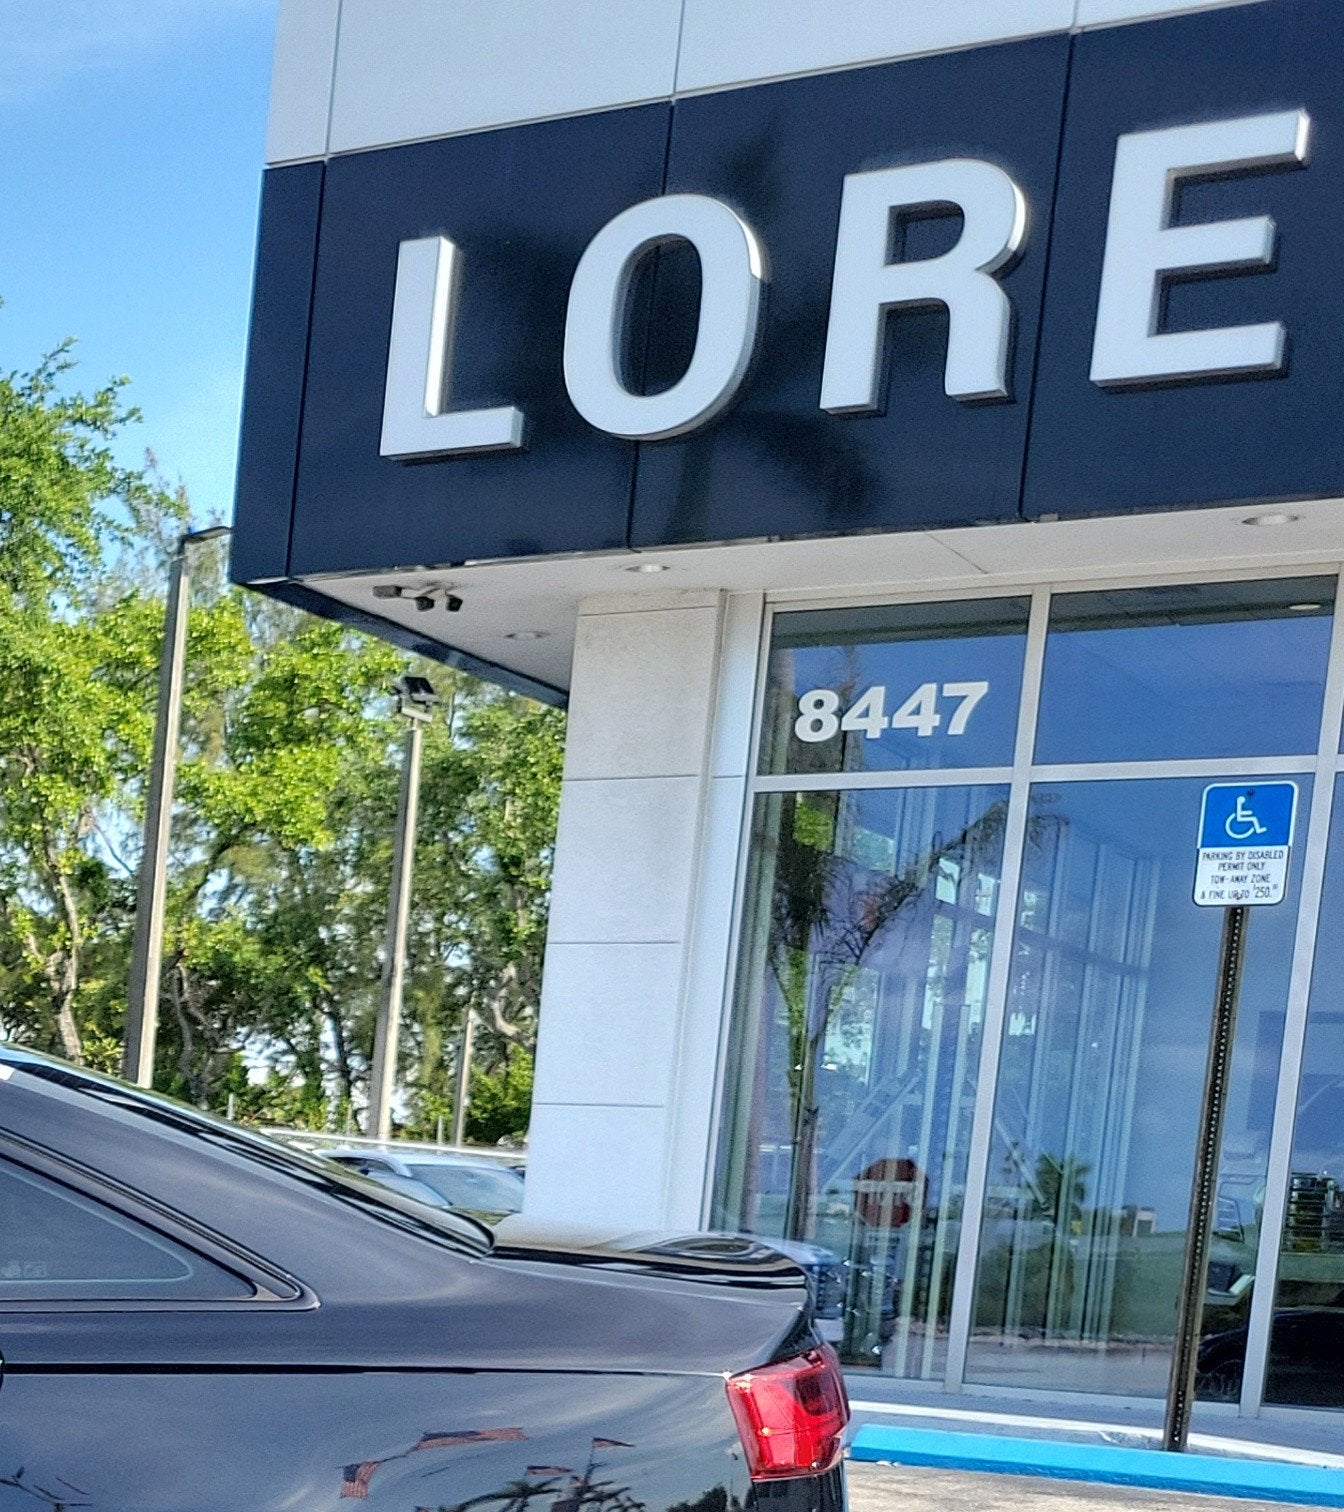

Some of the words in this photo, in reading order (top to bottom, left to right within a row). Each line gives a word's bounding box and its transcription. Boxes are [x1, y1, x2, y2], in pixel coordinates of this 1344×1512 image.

[379, 108, 1312, 460] LORE
[794, 681, 990, 743] 8447
[1202, 851, 1233, 861] PARKING
[1235, 851, 1246, 860] BY
[1247, 849, 1284, 860] DISABLED
[1217, 861, 1245, 872] PERMIT
[1247, 861, 1266, 871] ONLY
[1251, 873, 1271, 884] ZONE
[1208, 890, 1225, 900] FINE
